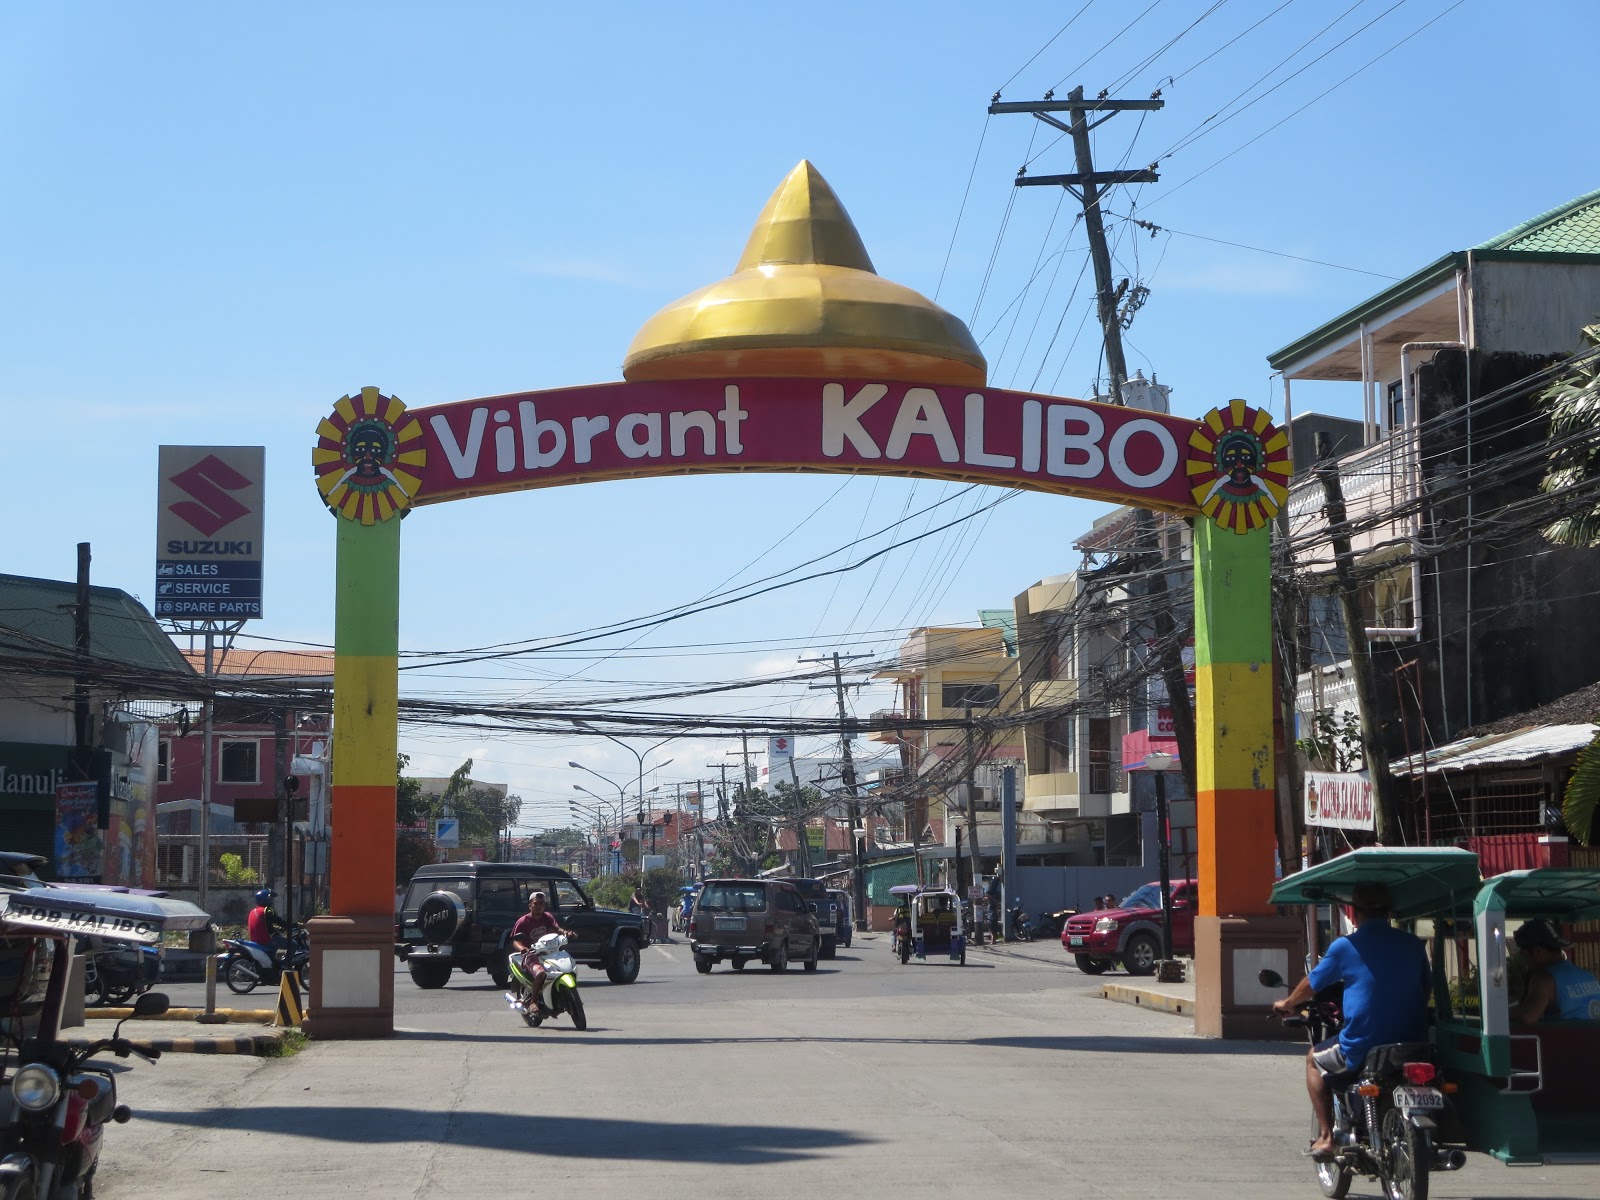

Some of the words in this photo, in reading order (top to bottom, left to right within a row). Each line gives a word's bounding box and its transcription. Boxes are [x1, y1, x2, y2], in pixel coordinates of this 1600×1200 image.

[428, 386, 749, 480] Vibrant
[822, 383, 1179, 489] KALIBO
[167, 540, 253, 555] SUZUKI
[175, 564, 219, 575] SALES
[175, 583, 231, 594] SERVICE
[174, 602, 216, 613] SPARE
[219, 602, 260, 613] PARTS
[67, 911, 151, 935] KALIBO
[423, 909, 449, 929] SAFARI
